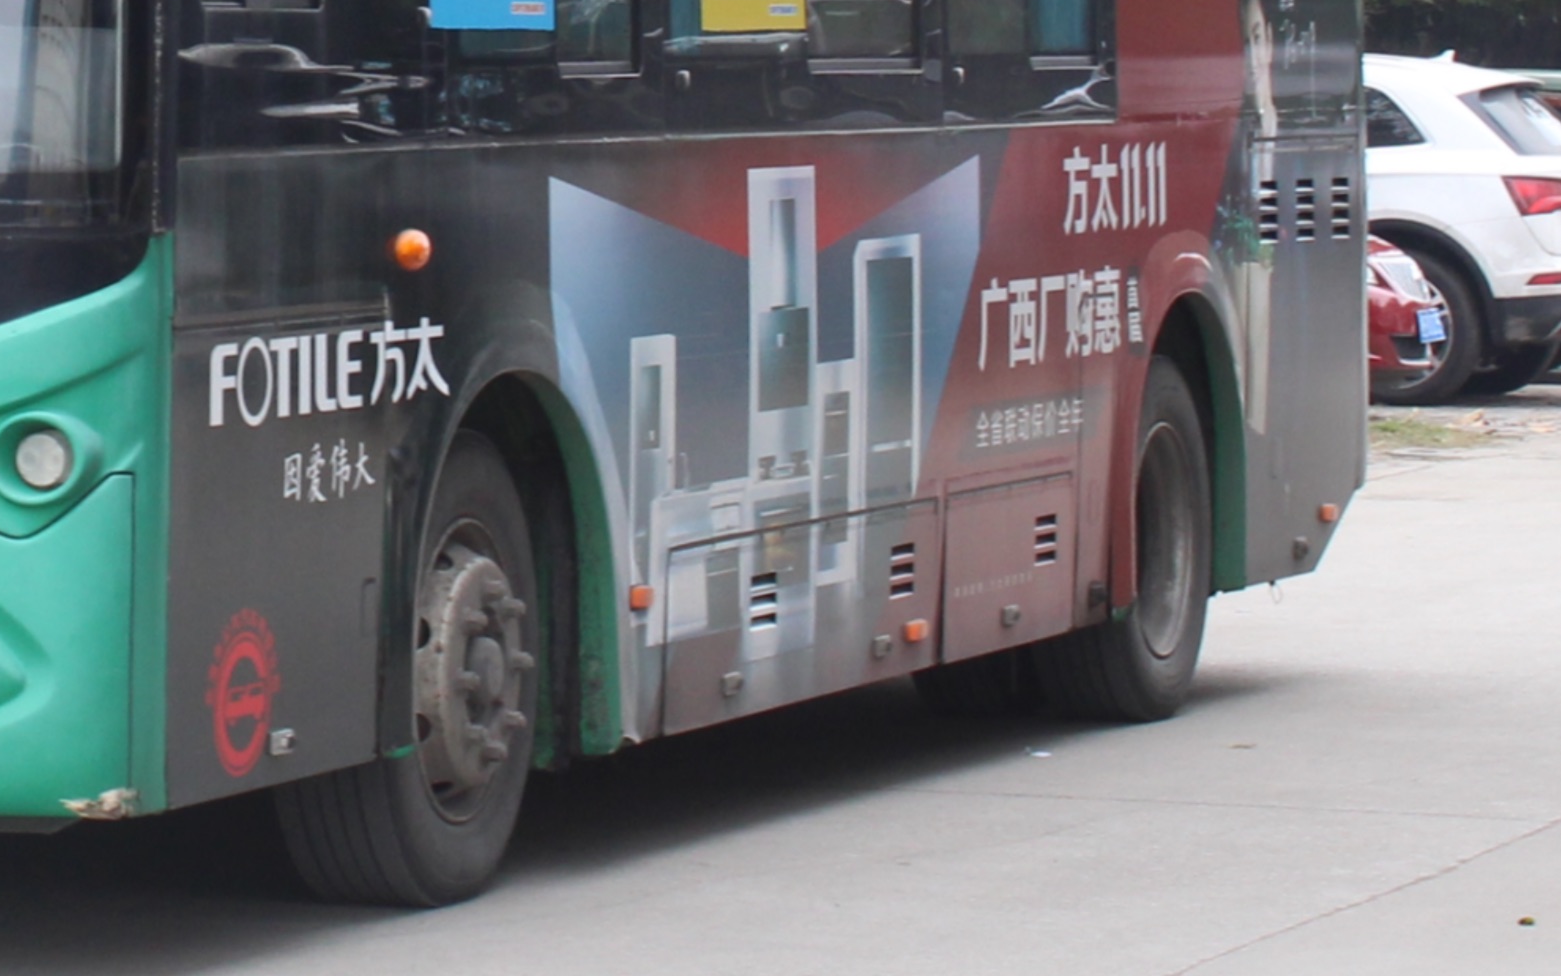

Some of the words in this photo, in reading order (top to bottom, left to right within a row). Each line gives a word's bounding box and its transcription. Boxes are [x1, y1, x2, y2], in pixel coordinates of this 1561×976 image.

[209, 327, 363, 426] FOTILE
[370, 316, 450, 406] 方太
[978, 265, 1121, 371] 广西厂购惠
[282, 437, 375, 503] 因爱伟大
